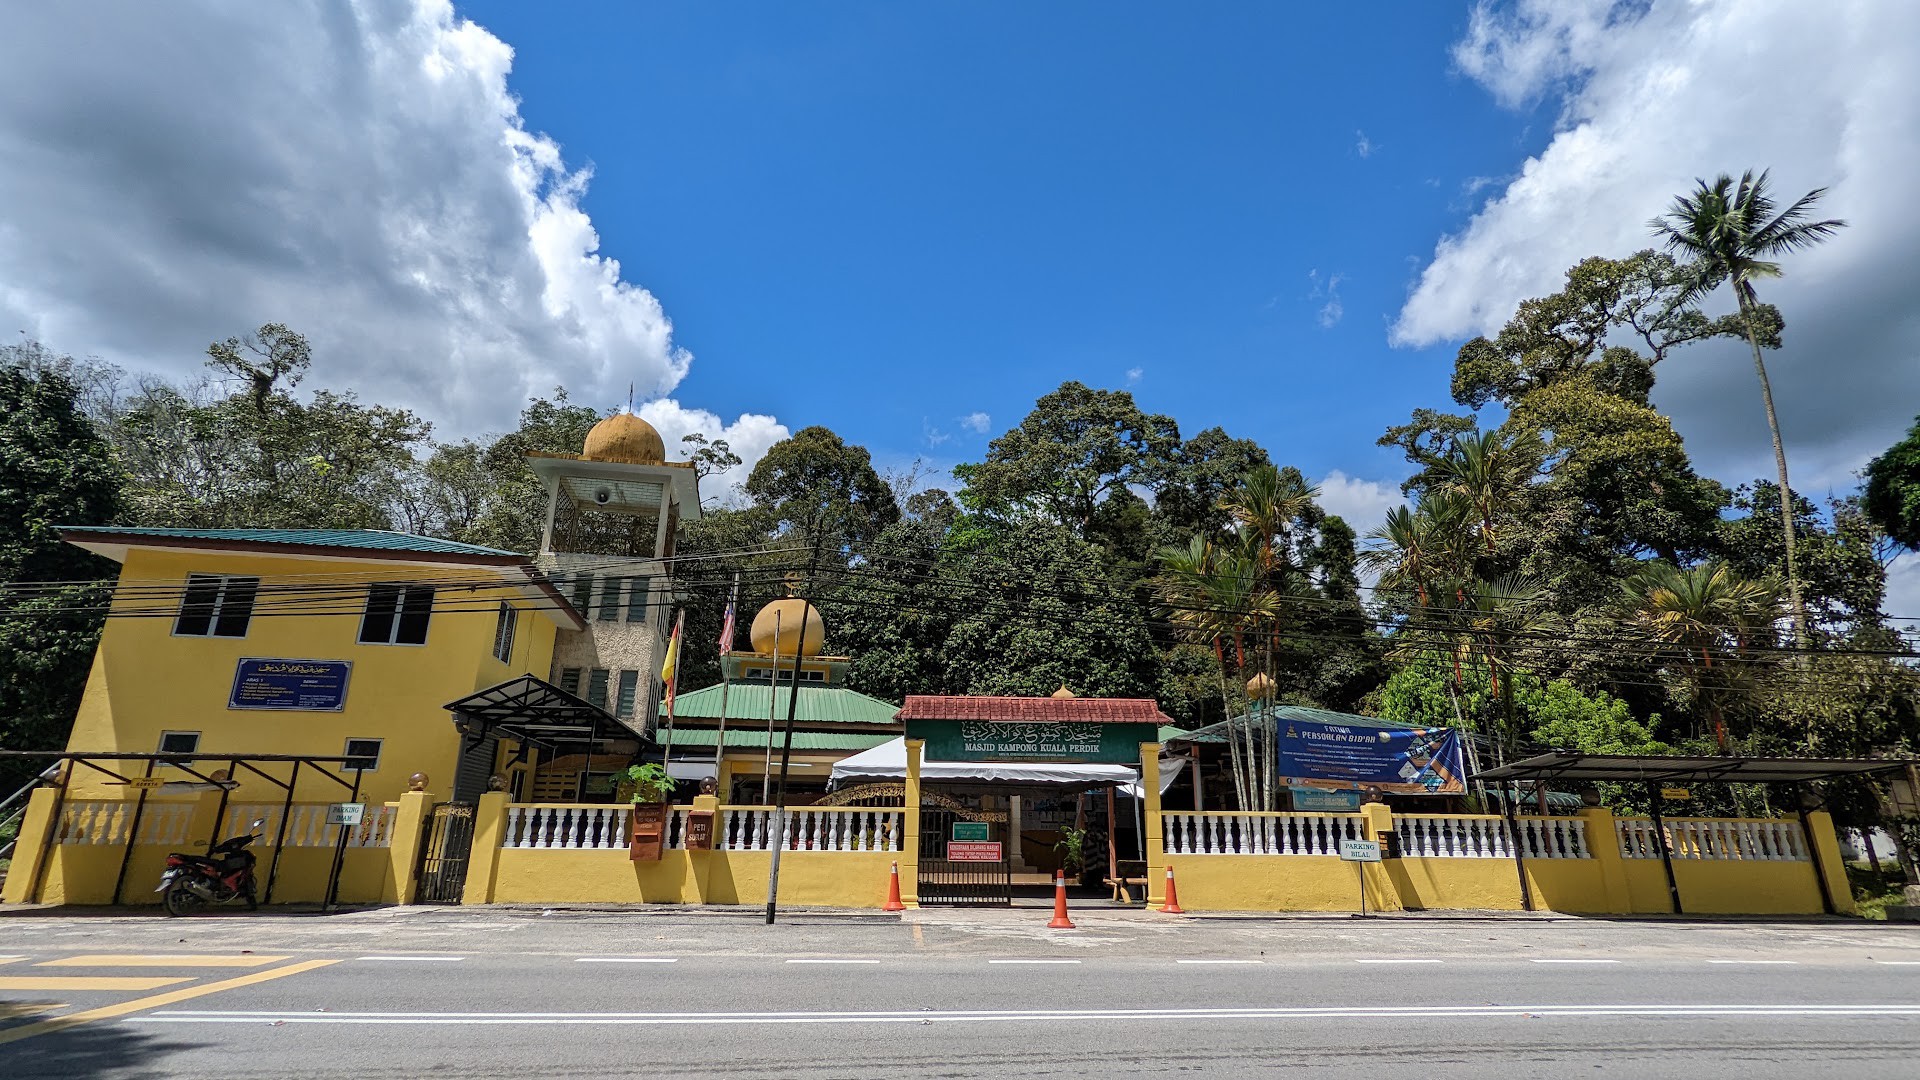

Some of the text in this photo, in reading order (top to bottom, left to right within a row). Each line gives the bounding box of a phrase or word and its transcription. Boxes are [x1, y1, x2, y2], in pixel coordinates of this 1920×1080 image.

[1324, 725, 1351, 734] FATWA
[1301, 731, 1376, 744] PERSOALAN BID'AH
[965, 743, 1100, 753] MASJID KAMPONG KUALA PERDIK
[693, 823, 706, 832] PETI
[688, 833, 706, 842] SURAT
